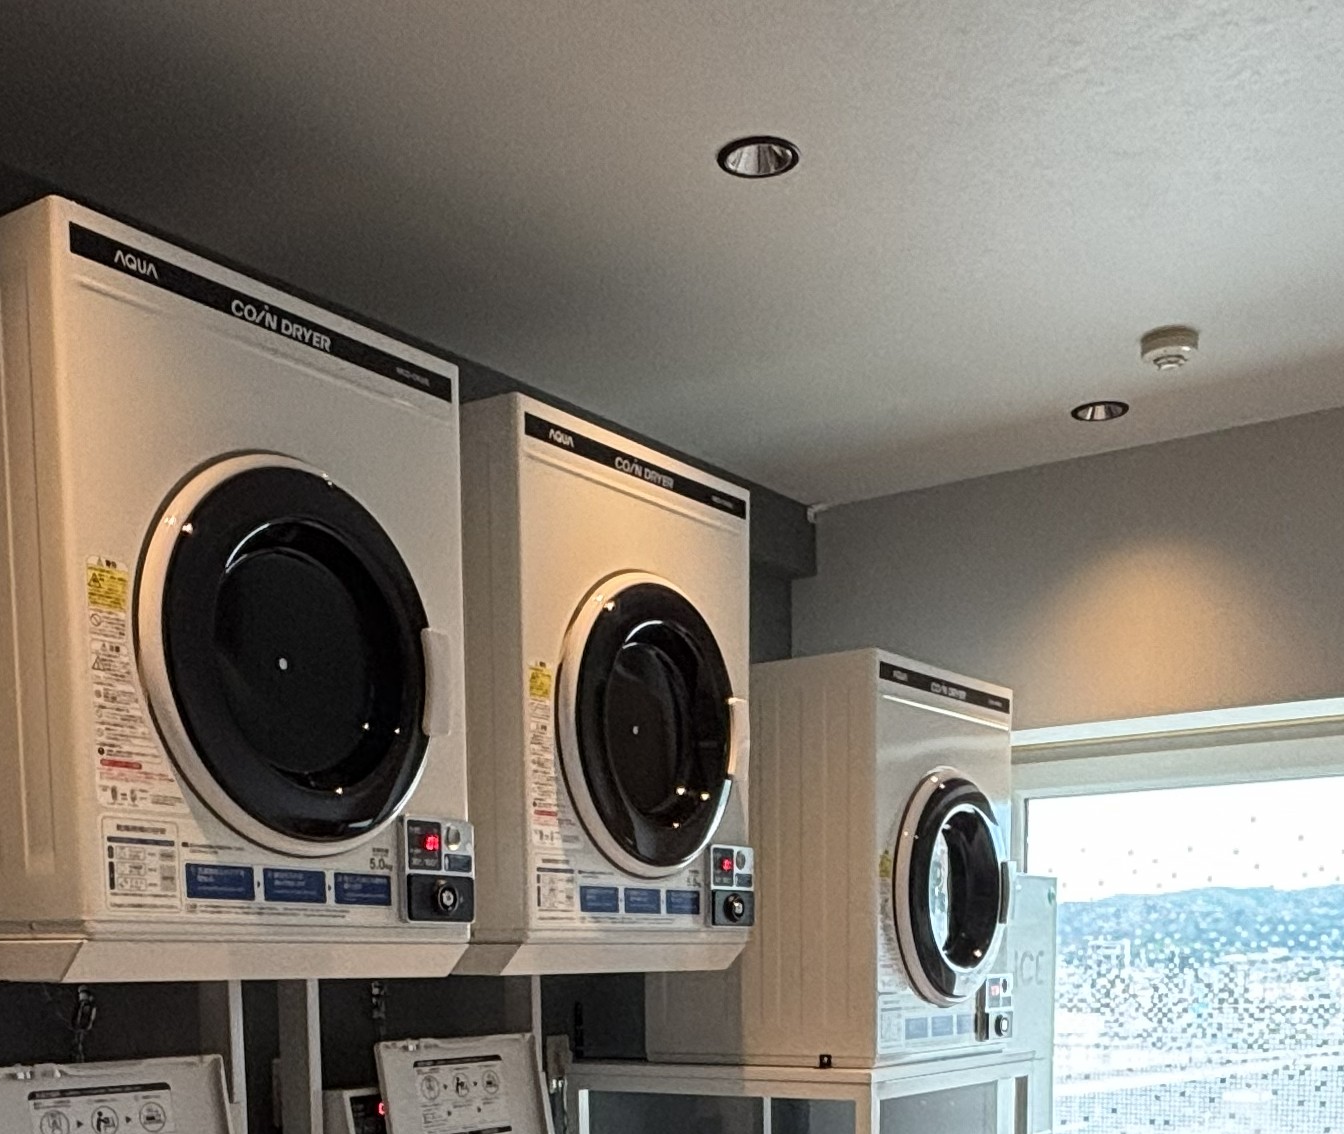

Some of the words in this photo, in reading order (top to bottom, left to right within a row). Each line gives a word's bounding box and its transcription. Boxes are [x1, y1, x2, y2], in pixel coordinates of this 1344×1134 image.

[113, 249, 160, 280] AQUA
[230, 300, 278, 331] COIN
[280, 318, 332, 353] DRYER
[548, 428, 575, 448] AQUA
[614, 457, 644, 479] COIN
[643, 467, 675, 491] DRYER
